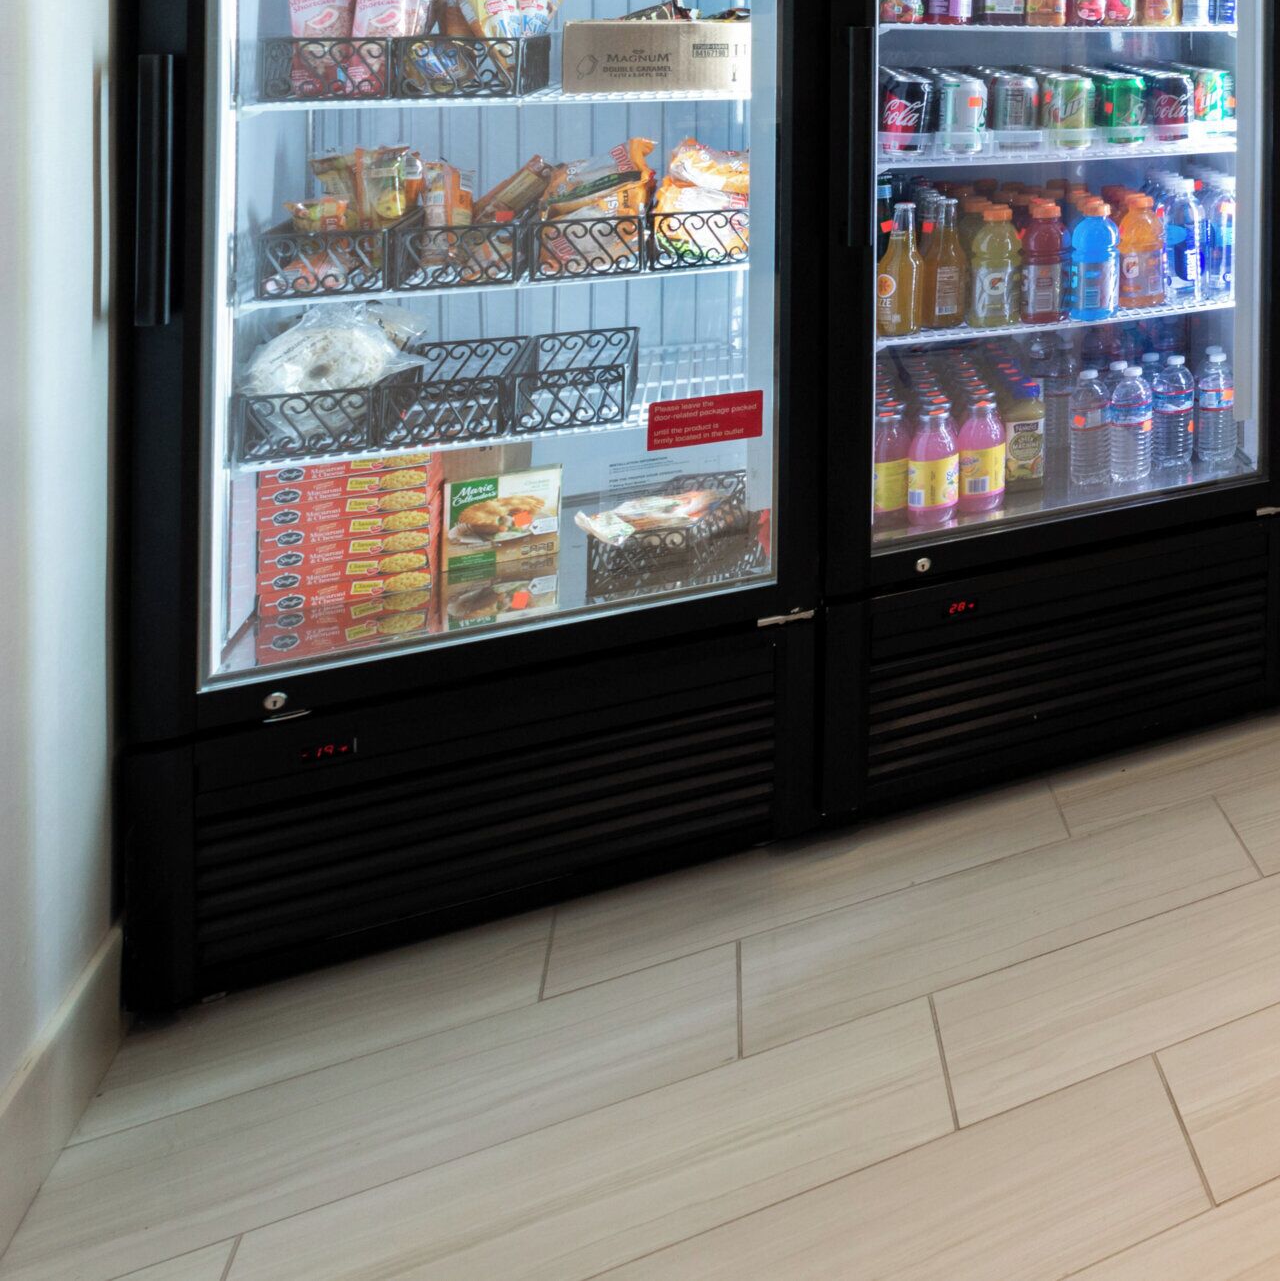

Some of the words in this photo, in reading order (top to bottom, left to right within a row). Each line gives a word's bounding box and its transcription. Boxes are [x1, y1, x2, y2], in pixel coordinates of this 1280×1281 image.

[607, 53, 669, 62] MAGNUM
[654, 412, 698, 421] door-related
[699, 408, 729, 416] package
[731, 404, 756, 413] packed
[654, 428, 669, 436] until
[684, 424, 711, 433] product
[307, 488, 342, 496] Macaroni
[454, 483, 495, 496] Marie
[452, 491, 497, 506] Callender's
[310, 530, 344, 538] Macaroni
[311, 592, 345, 601] Macaroni
